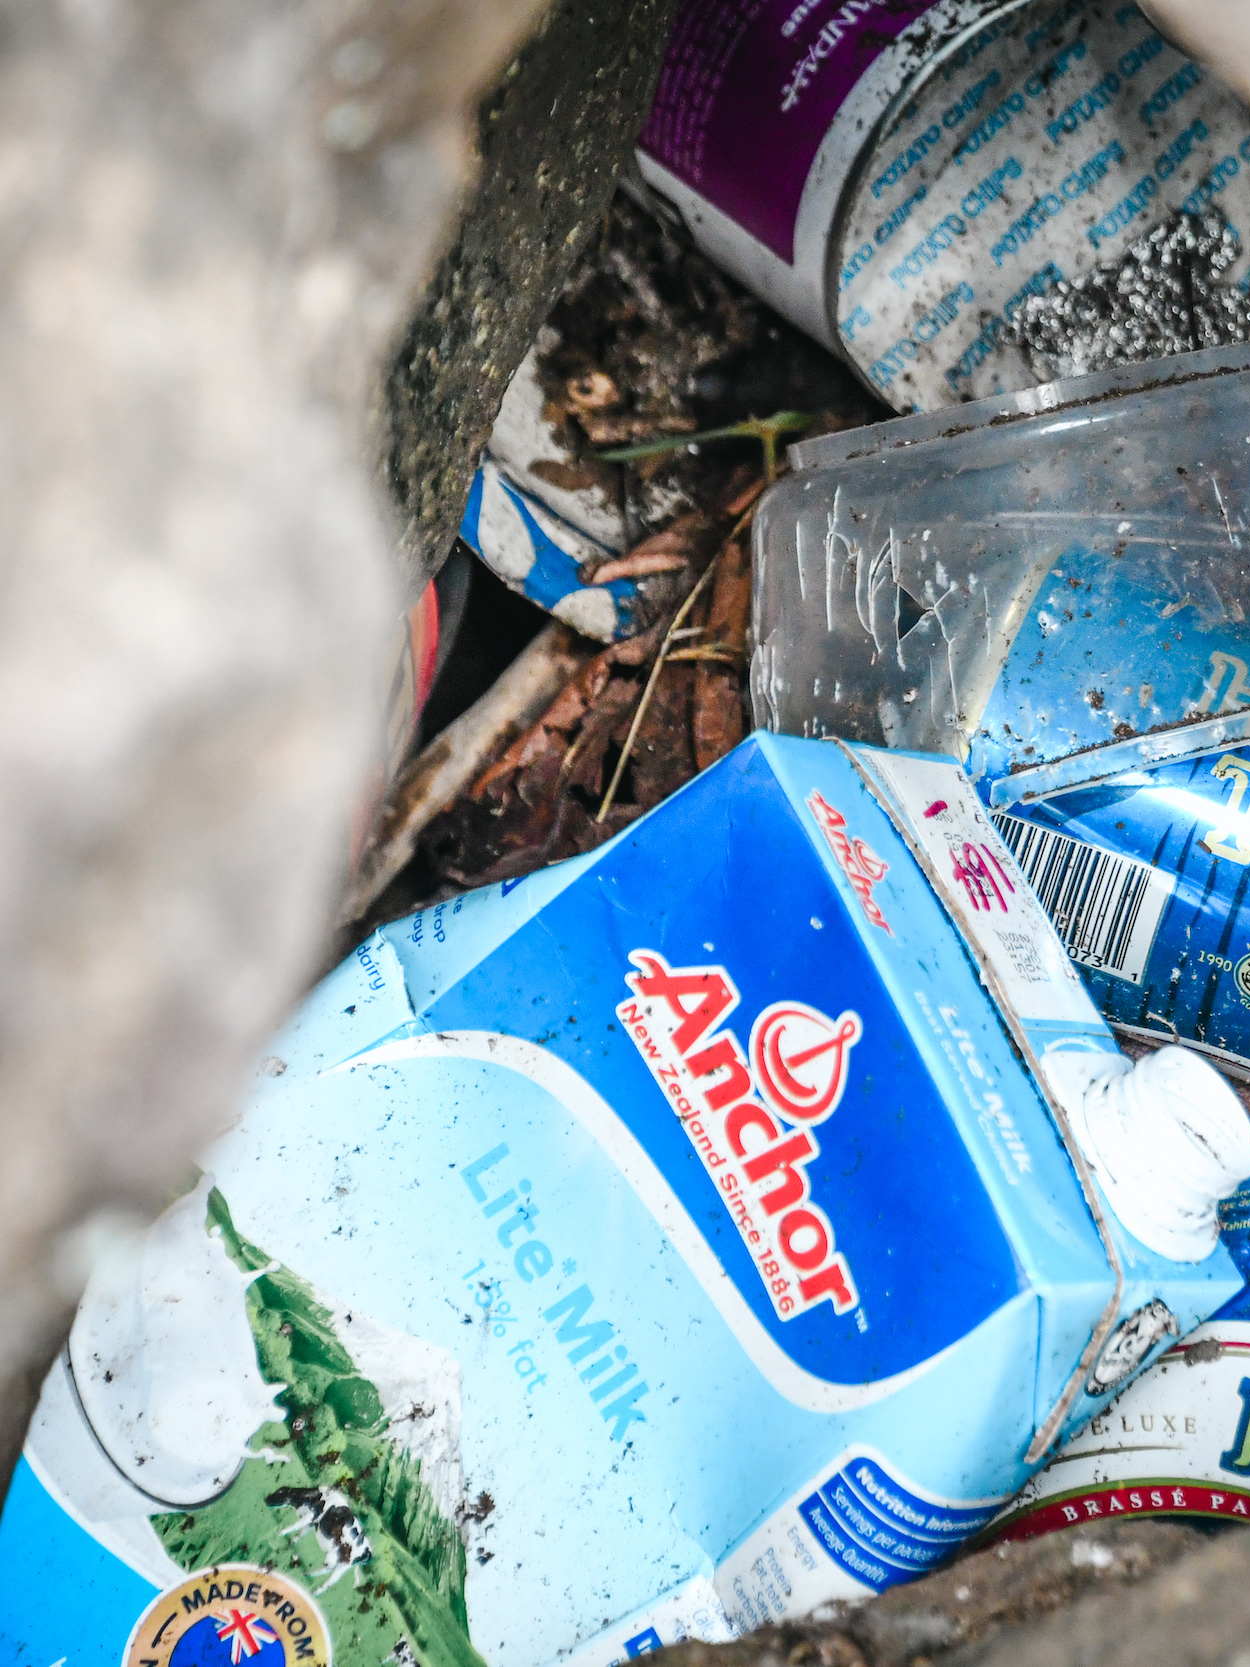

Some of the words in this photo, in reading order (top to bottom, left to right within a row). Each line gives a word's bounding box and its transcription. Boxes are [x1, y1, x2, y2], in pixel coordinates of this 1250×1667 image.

[890, 214, 966, 290] POTATO
[961, 157, 1022, 218] CHIPS
[990, 194, 1062, 266] POTATO
[1060, 140, 1124, 198] CHIPS
[1087, 174, 1156, 249] POTATO
[914, 281, 974, 343] CHIPS
[805, 788, 895, 938] Anchor
[434, 903, 448, 943] drop
[356, 945, 386, 991] dairy
[1198, 950, 1233, 973] 1990
[621, 1003, 661, 1060] New
[658, 1064, 727, 1170] Zealand
[718, 1172, 760, 1244] Since
[757, 1247, 795, 1313] 1886
[631, 956, 854, 1304] Anchor
[983, 1093, 1032, 1174] Milk
[506, 1339, 547, 1394] fat
[542, 1283, 650, 1444] Milk
[1120, 1413, 1198, 1437] LUXE
[831, 1487, 875, 1540] Servings
[872, 1528, 899, 1553] per
[855, 1466, 926, 1528] Nutrition
[1062, 1489, 1187, 1523] BRASSÉ
[765, 1547, 793, 1597] Protein
[786, 1524, 818, 1573] Energy
[809, 1507, 844, 1552] Average
[842, 1550, 888, 1584] Quantity
[181, 1581, 262, 1614] MADE
[766, 1584, 786, 1616] total
